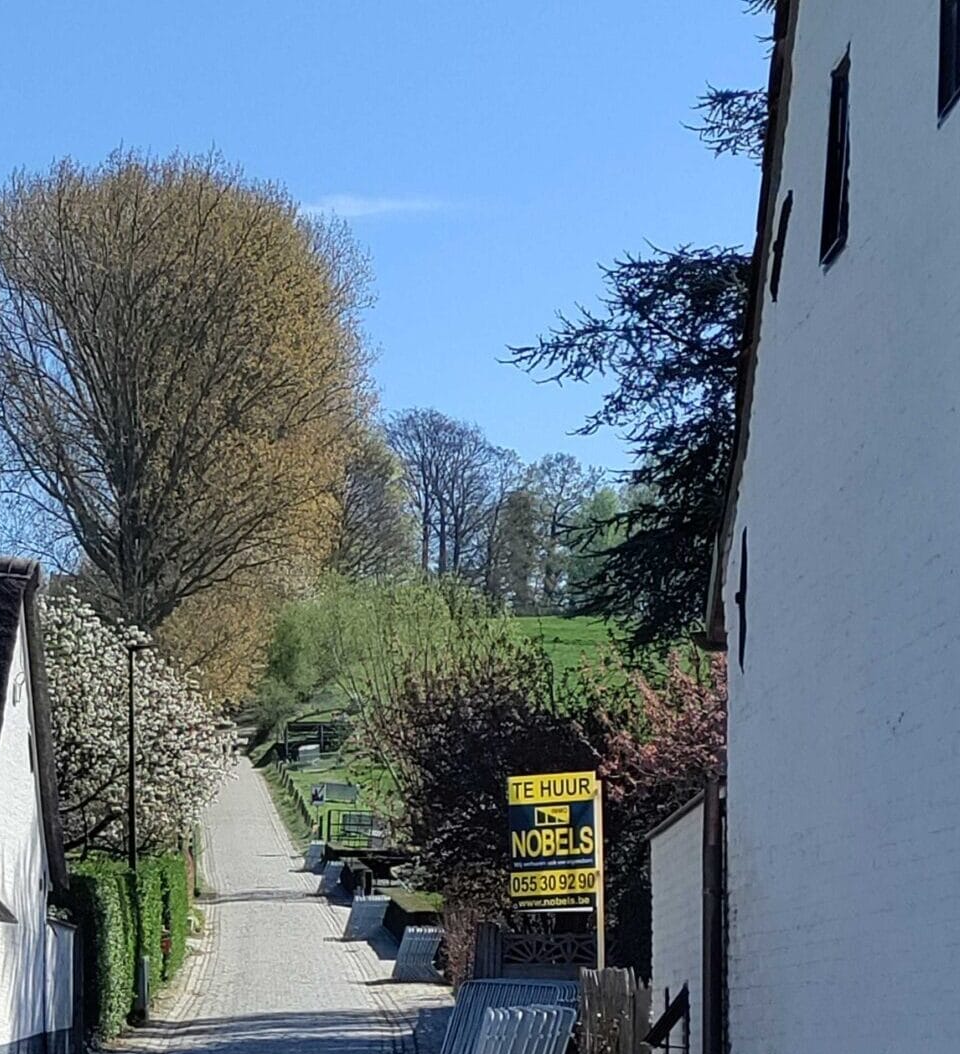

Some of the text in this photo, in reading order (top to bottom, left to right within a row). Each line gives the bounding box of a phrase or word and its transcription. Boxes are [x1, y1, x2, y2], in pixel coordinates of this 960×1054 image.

[513, 778, 591, 799] TE HUUR
[512, 826, 594, 858] NOBELS
[513, 872, 595, 893] 055 30 92 90
